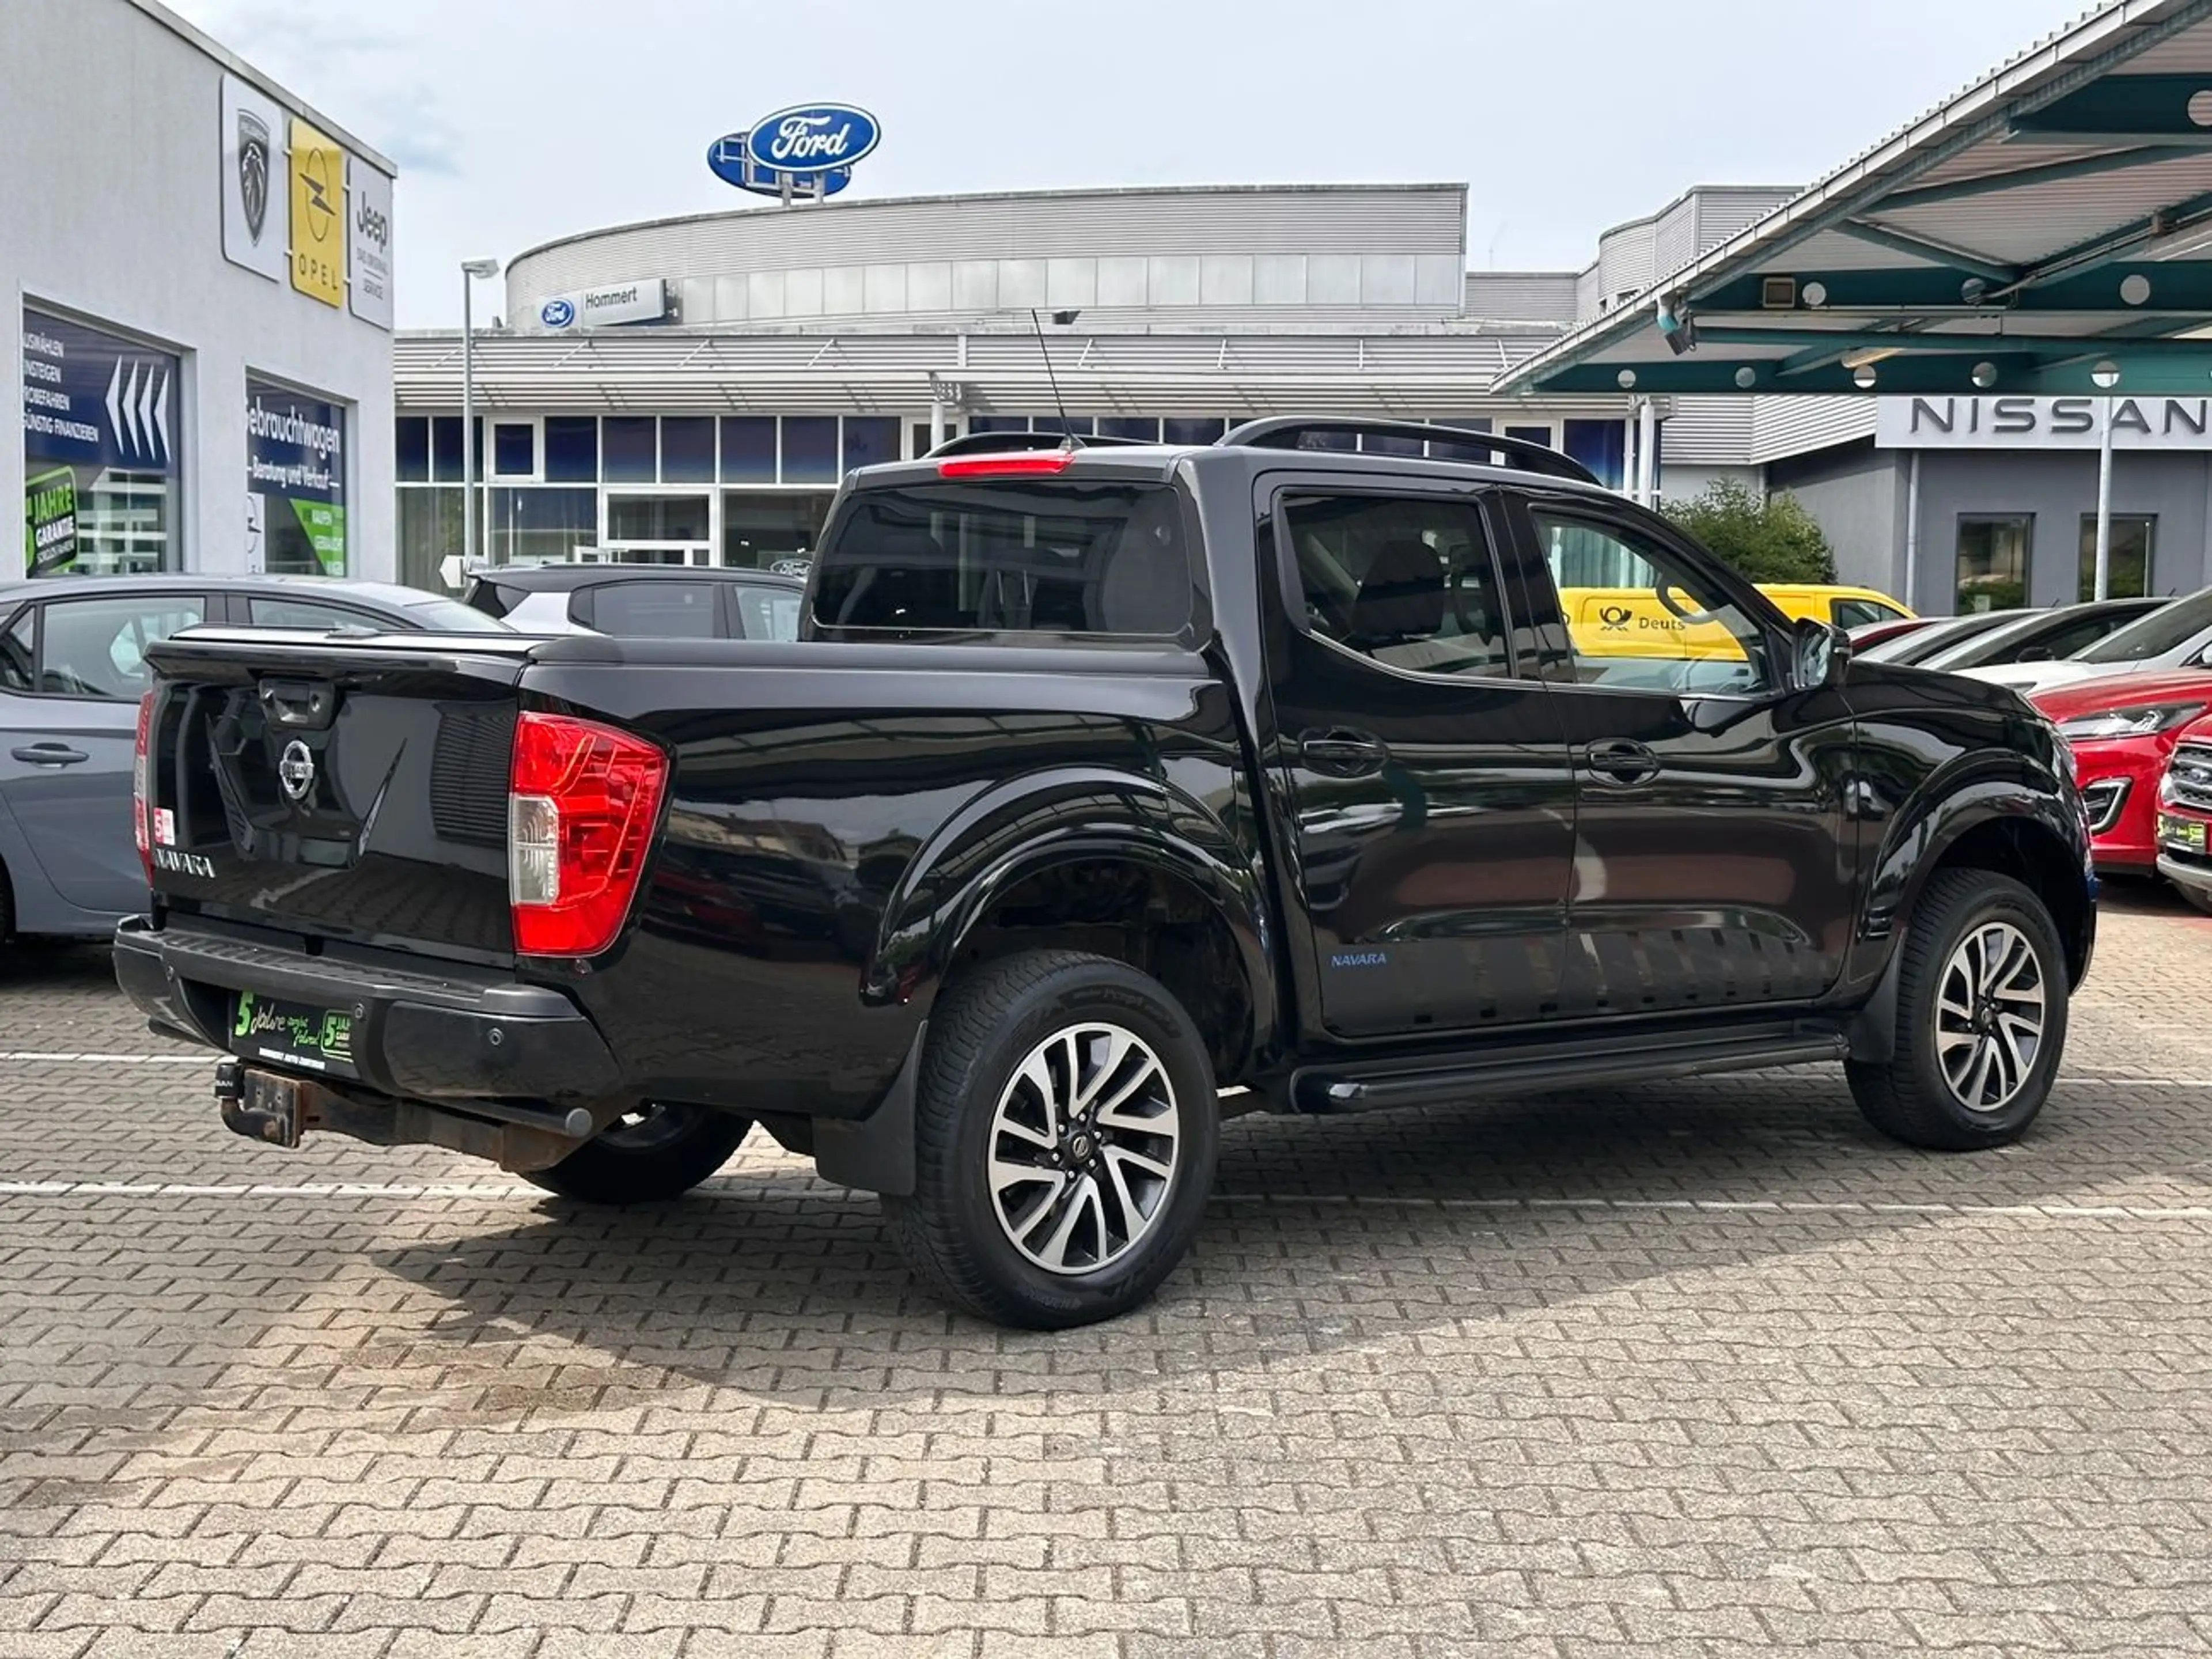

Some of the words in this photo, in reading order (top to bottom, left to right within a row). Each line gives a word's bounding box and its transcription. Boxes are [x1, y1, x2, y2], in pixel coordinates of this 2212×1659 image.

[771, 116, 851, 159] Ford
[357, 191, 387, 253] Jeep
[298, 253, 338, 291] OPEL
[545, 304, 566, 322] Ford
[585, 287, 637, 309] Hommert
[247, 396, 340, 460] ebrauchtwagen
[1910, 397, 2206, 435] NISSAN
[288, 464, 301, 486] und
[35, 482, 73, 525] JAHRE
[155, 848, 215, 878] NAVARA
[1331, 952, 1387, 968] NAVARA
[235, 990, 254, 1036] 5
[324, 1017, 336, 1046] 5
